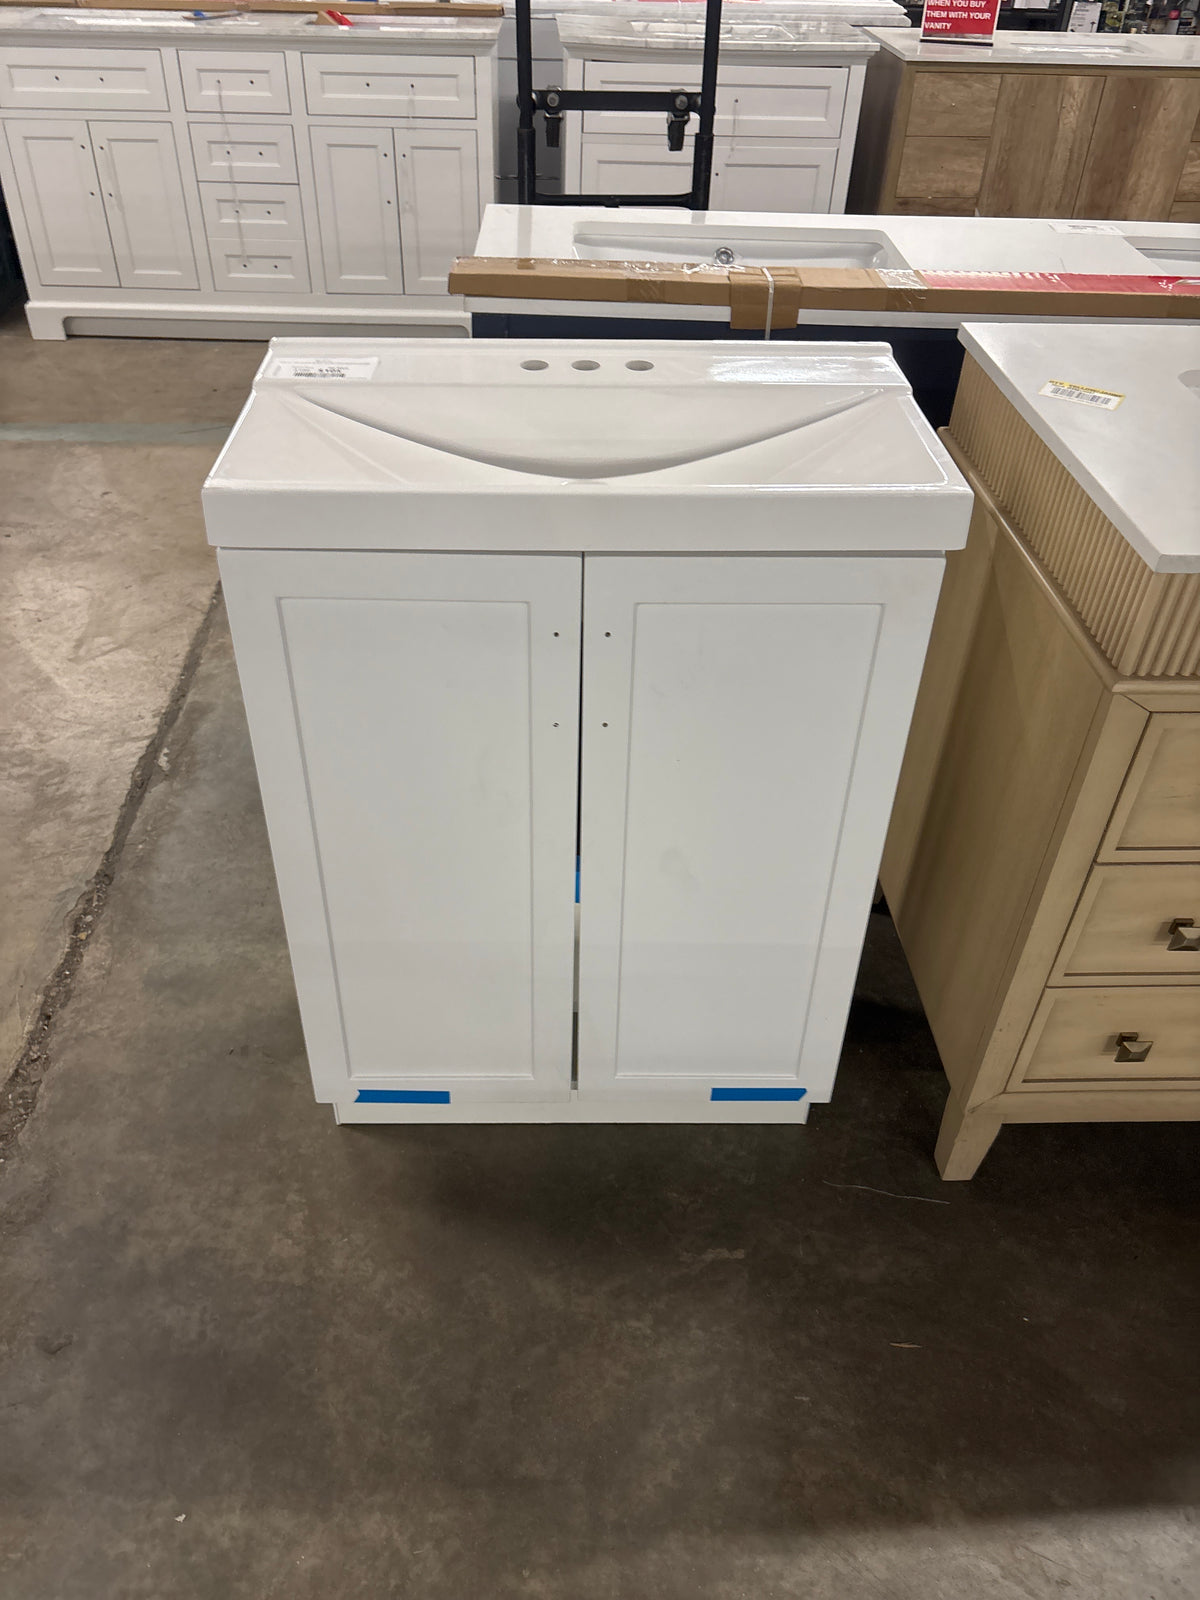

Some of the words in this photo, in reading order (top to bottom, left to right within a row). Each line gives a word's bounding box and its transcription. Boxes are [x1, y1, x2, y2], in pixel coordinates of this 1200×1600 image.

[926, 10, 947, 18] THEM
[969, 12, 991, 20] YOUR
[924, 22, 952, 30] VANITY
